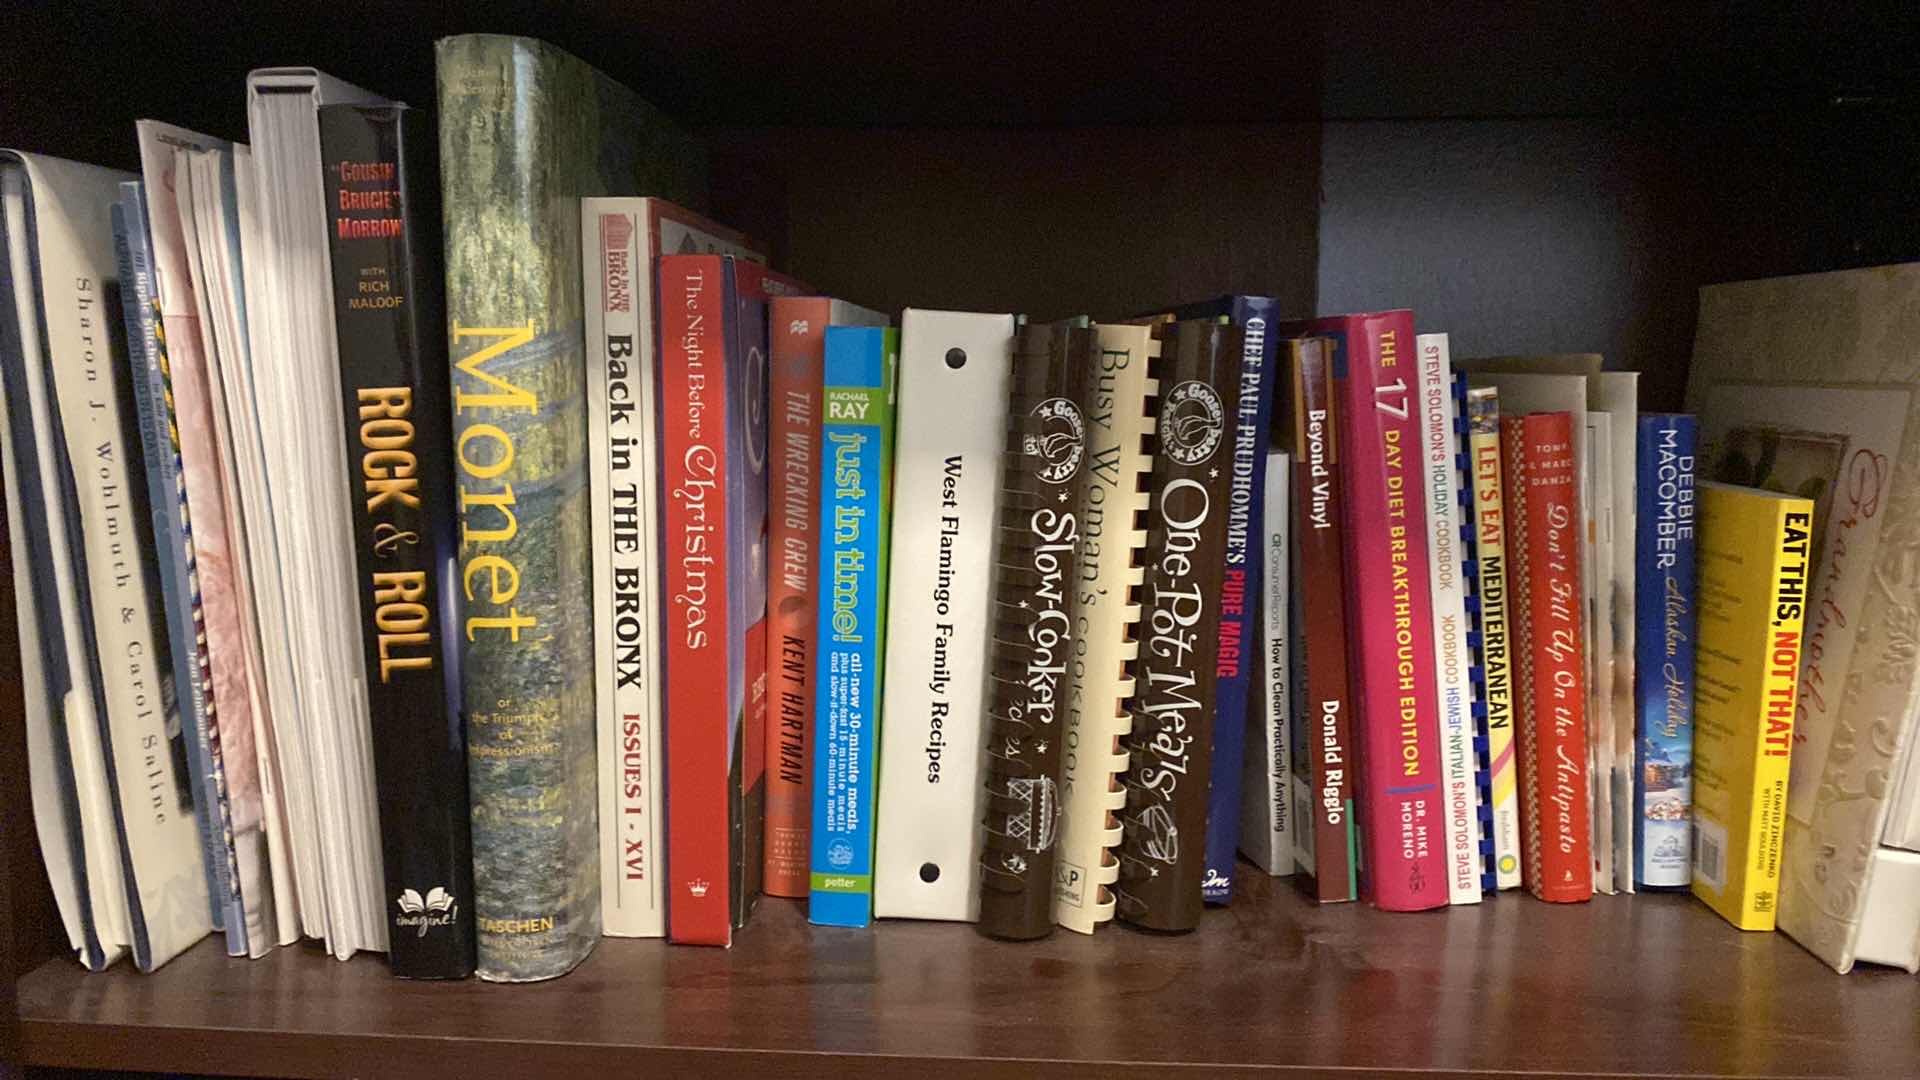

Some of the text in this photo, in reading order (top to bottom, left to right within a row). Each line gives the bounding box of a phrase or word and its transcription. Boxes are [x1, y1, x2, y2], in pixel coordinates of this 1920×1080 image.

[337, 217, 402, 240] MORROW
[136, 270, 152, 317] Ripple
[350, 296, 404, 309] MALOOF
[359, 281, 390, 293] RICH
[360, 267, 386, 277] WITH
[607, 251, 622, 312] BRONX
[143, 317, 159, 372] Stitches
[607, 334, 636, 425] Back
[829, 391, 870, 401] RACHAEL
[829, 402, 870, 420] RAY
[453, 319, 538, 642] Monet
[611, 437, 638, 471] in
[673, 269, 718, 650] The Night Before Christmas
[783, 391, 811, 591] THE WRECKING CREW
[1308, 409, 1331, 529] Beyond Vinyl
[1423, 345, 1452, 591] STEVE SOLOMON'S HOLIDAY COOKBOOK
[357, 386, 432, 685] ROCK & ROLL
[612, 483, 640, 556] THE
[828, 431, 868, 644] just in time!
[1215, 316, 1267, 679] CHEF PAUL PRUDHOMME'S PURE MAGIC
[1656, 429, 1679, 569] MACOMBER
[1677, 455, 1695, 541] DEBBIE
[76, 277, 167, 827] Sharon J. Wohlmuth & Carol Saline
[1064, 347, 1130, 794] Busy Woman's COOKBOOK
[1150, 478, 1211, 668] One-Pot
[1374, 329, 1420, 778] THE 17 DAY DIET BREAKTHROUGH EDITION
[1477, 446, 1510, 730] LET'S EAT MEDITERRANEAN
[614, 568, 642, 691] BRONX
[927, 455, 964, 784] West Flamingo Family Recipes
[1027, 508, 1080, 724] Slow-Cooker
[1654, 576, 1688, 737] Alaskan Holiday
[1764, 512, 1810, 757] EAT THIS, NOT THAT!
[830, 651, 840, 673] and
[839, 652, 850, 674] plus
[849, 652, 863, 708] all-new
[1545, 502, 1580, 854] Don't Fill Up On the Antipasto
[780, 634, 806, 786] KENT HARTMAN
[848, 711, 862, 784] 30-minute
[1271, 637, 1287, 832] How to Clean Practically Anything
[1322, 700, 1343, 764] Donald
[1441, 615, 1473, 890] STEVE SOLOMON'S ITALIAN-JEWISH COOKBOOK
[622, 713, 643, 800] ISSUES
[1775, 779, 1783, 792] BY
[827, 799, 837, 832] meals
[837, 795, 846, 832] meals
[1400, 801, 1414, 859] MORENO
[1415, 799, 1428, 857] DR. MIKE
[1773, 793, 1782, 823] DAVID
[626, 839, 644, 881] XVI
[824, 878, 857, 888] potter
[478, 916, 555, 934] TASCHEN
